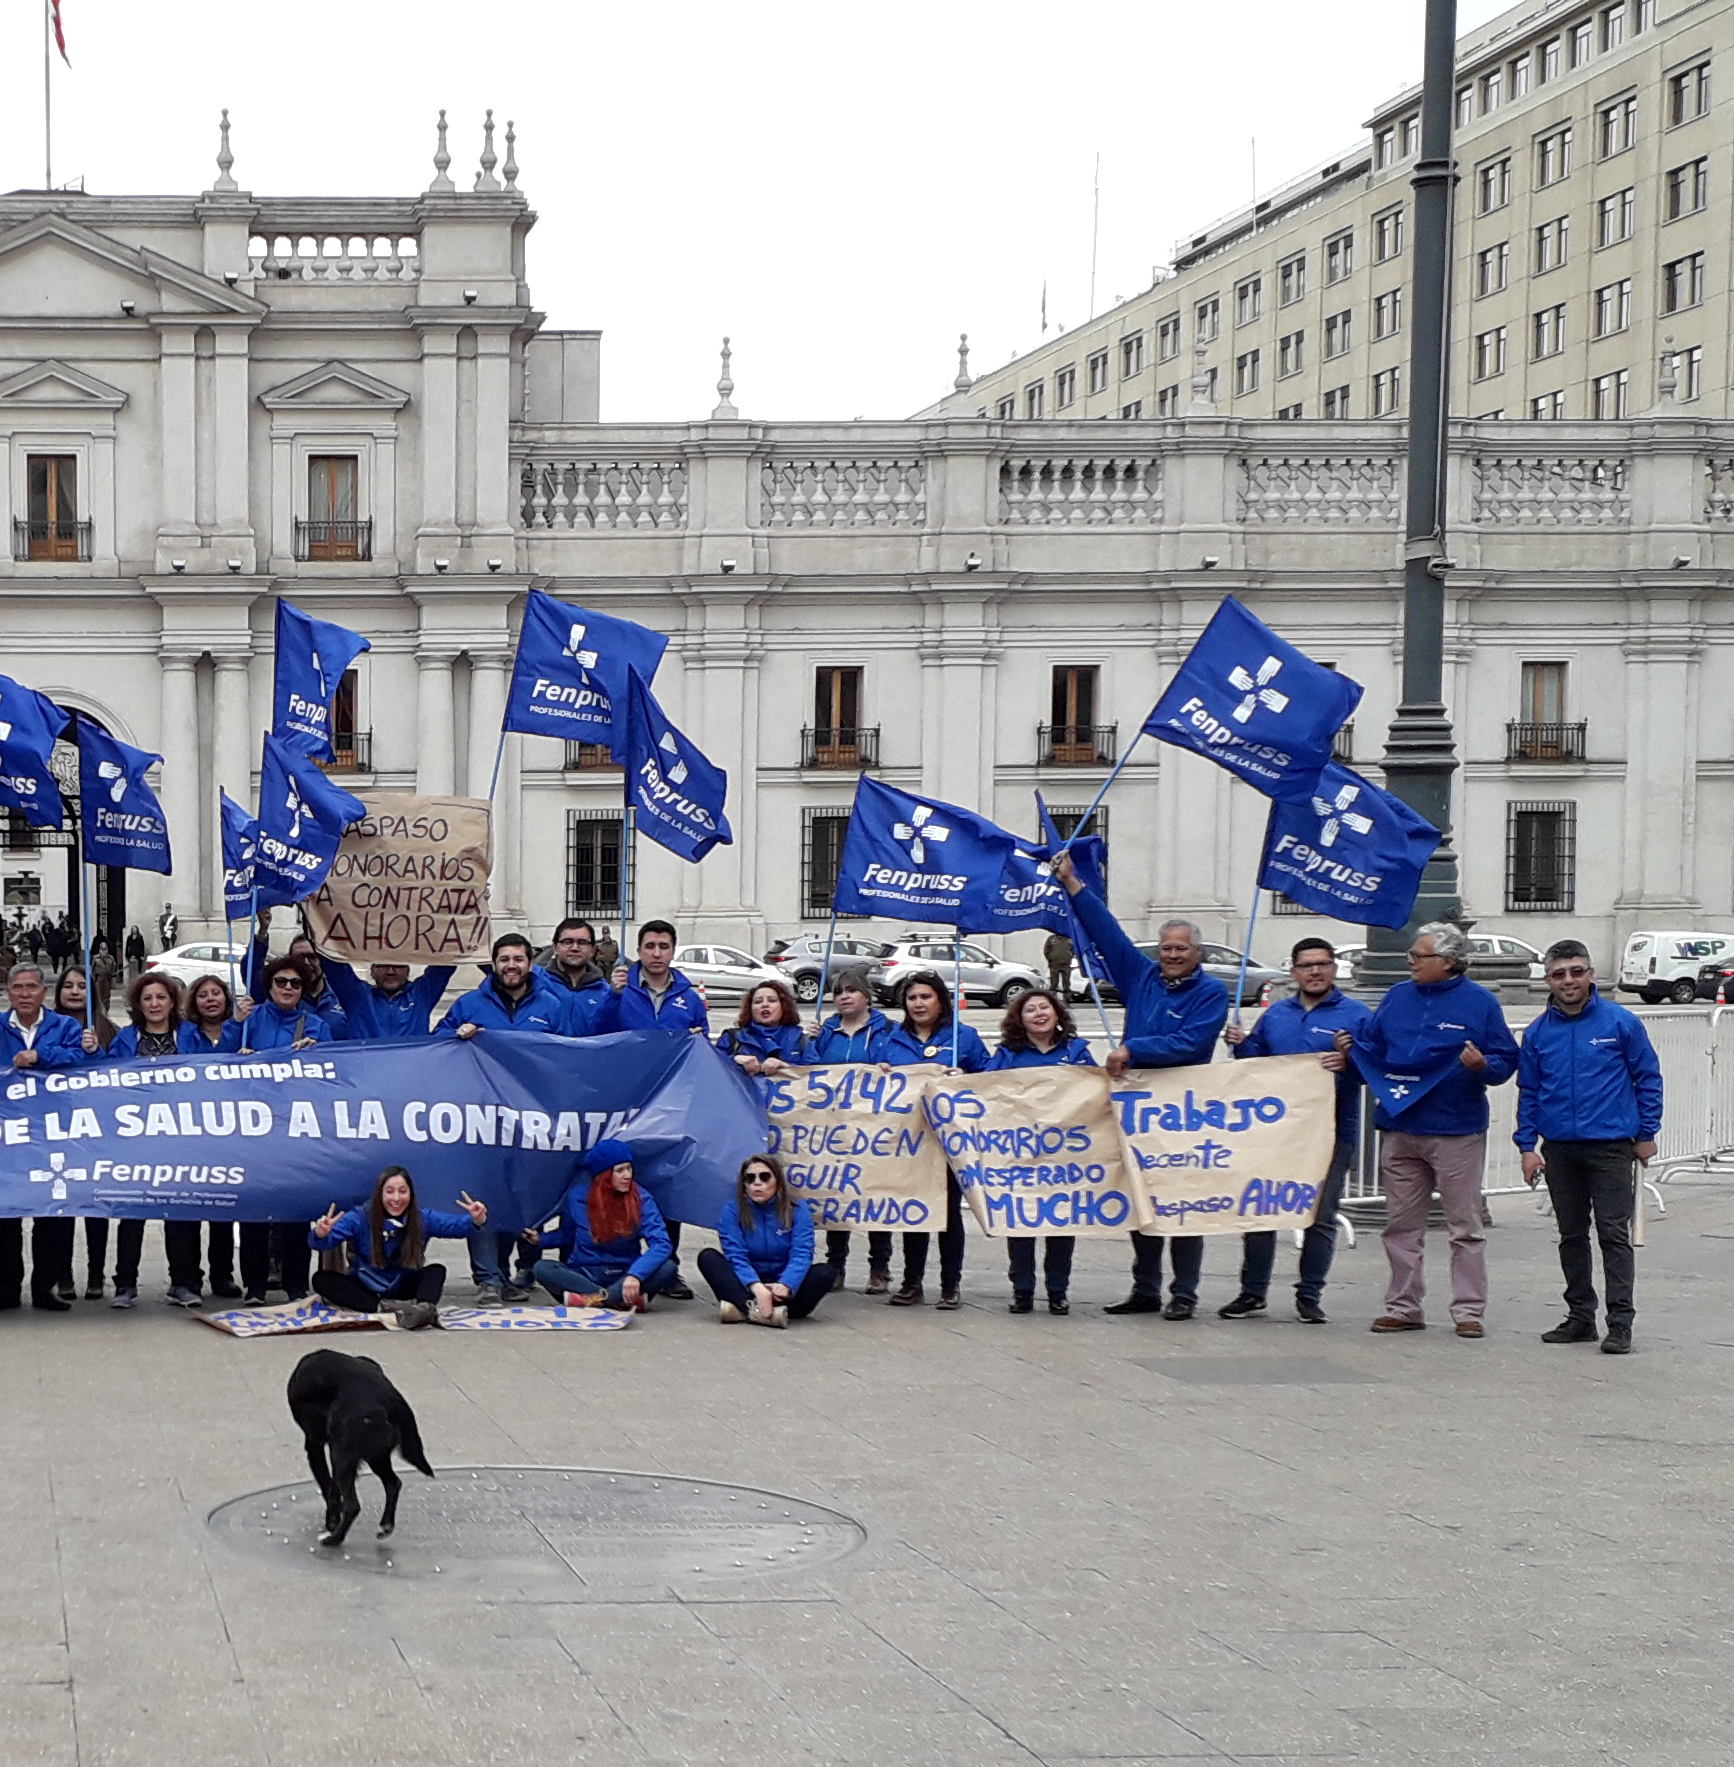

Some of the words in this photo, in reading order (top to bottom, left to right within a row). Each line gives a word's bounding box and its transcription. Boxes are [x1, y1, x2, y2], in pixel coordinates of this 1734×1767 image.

[863, 863, 968, 891] Fenpruss
[316, 883, 334, 906] A
[351, 883, 481, 915] CONTRATA
[1675, 940, 1726, 957] WSP
[7, 1077, 37, 1100] el
[46, 1067, 197, 1094] Gobierno
[205, 1058, 337, 1083] cumpla:
[45, 1107, 103, 1141] LA
[115, 1100, 273, 1137] SALUD
[288, 1101, 322, 1139] A
[334, 1100, 391, 1140] LA
[921, 1089, 986, 1131] LOS
[792, 1124, 925, 1157] PUEDEN
[93, 1160, 246, 1187] Fenpruss
[985, 1190, 1130, 1228] MUCHO
